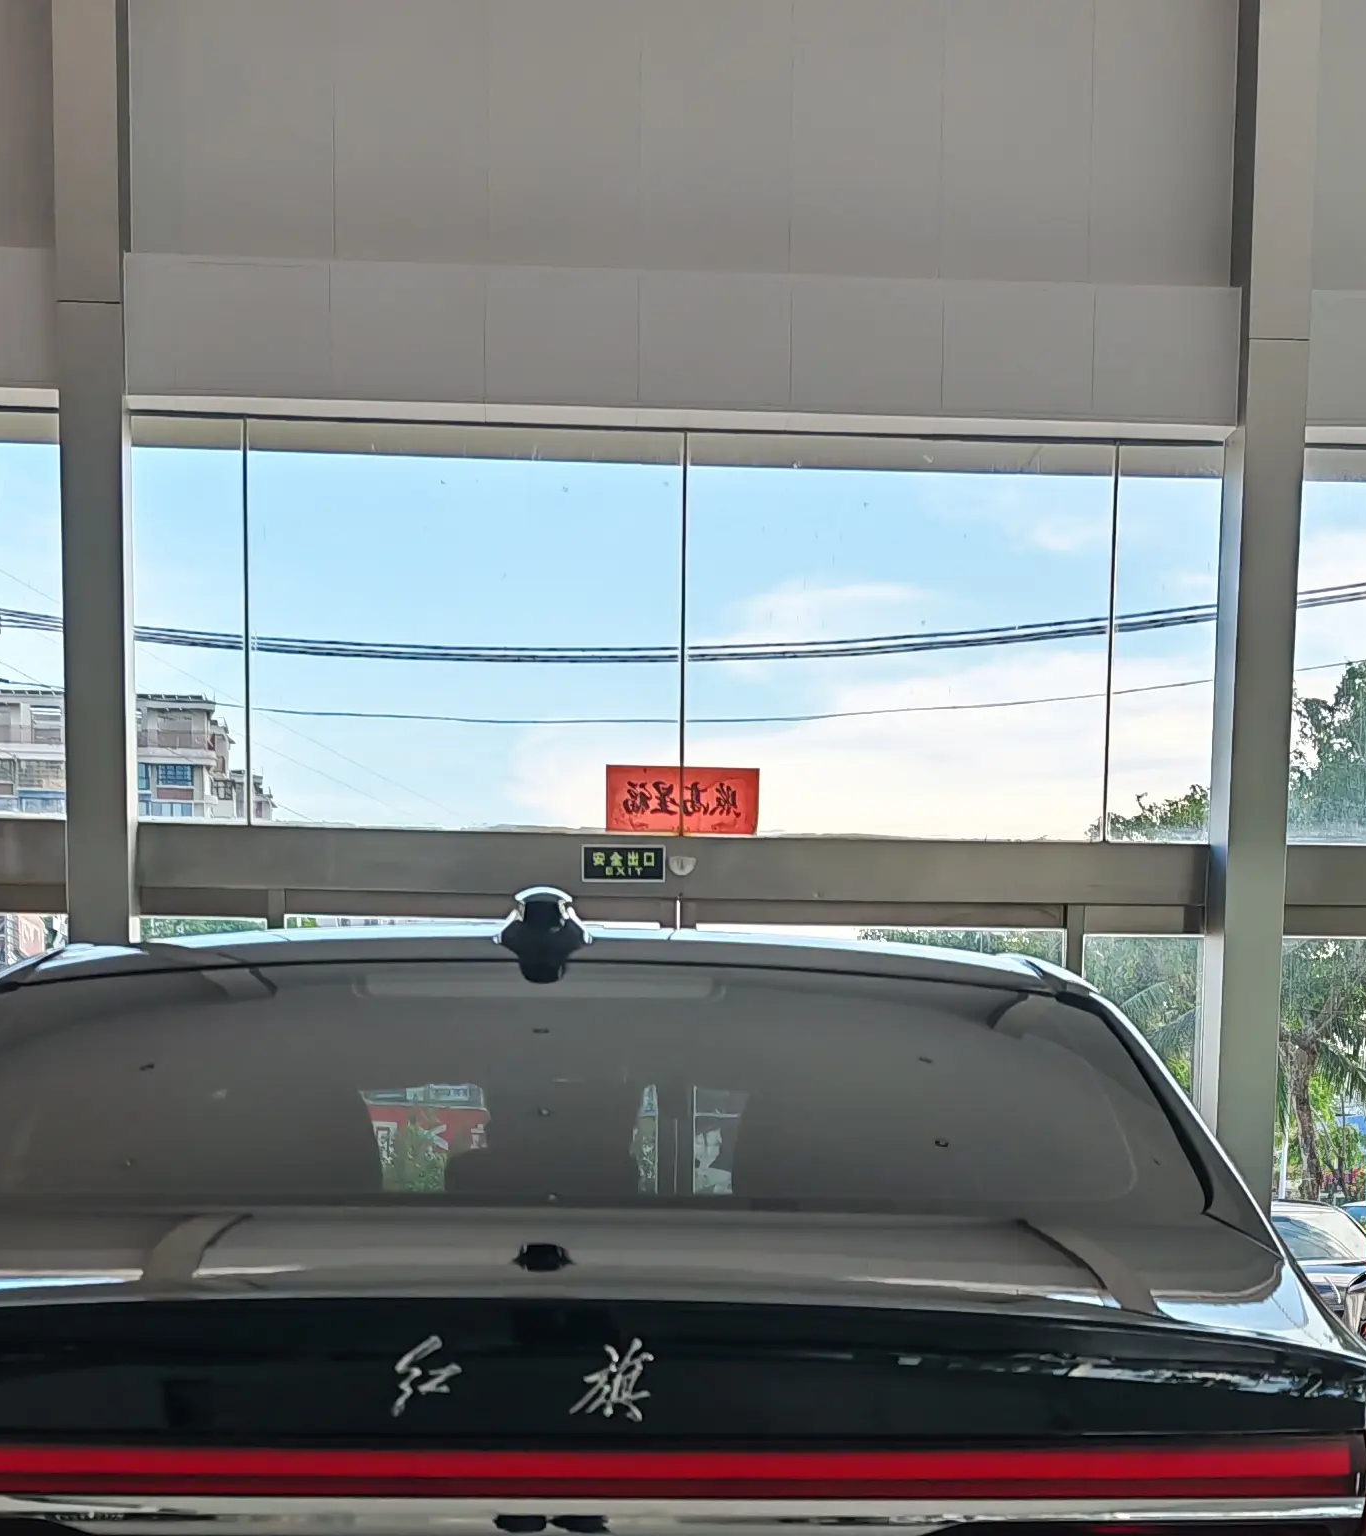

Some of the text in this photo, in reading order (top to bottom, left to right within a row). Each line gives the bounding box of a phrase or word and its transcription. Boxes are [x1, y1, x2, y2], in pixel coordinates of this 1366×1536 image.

[592, 852, 655, 867] 安全出口
[605, 866, 644, 876] EXIT
[391, 1335, 655, 1422] 红旗
